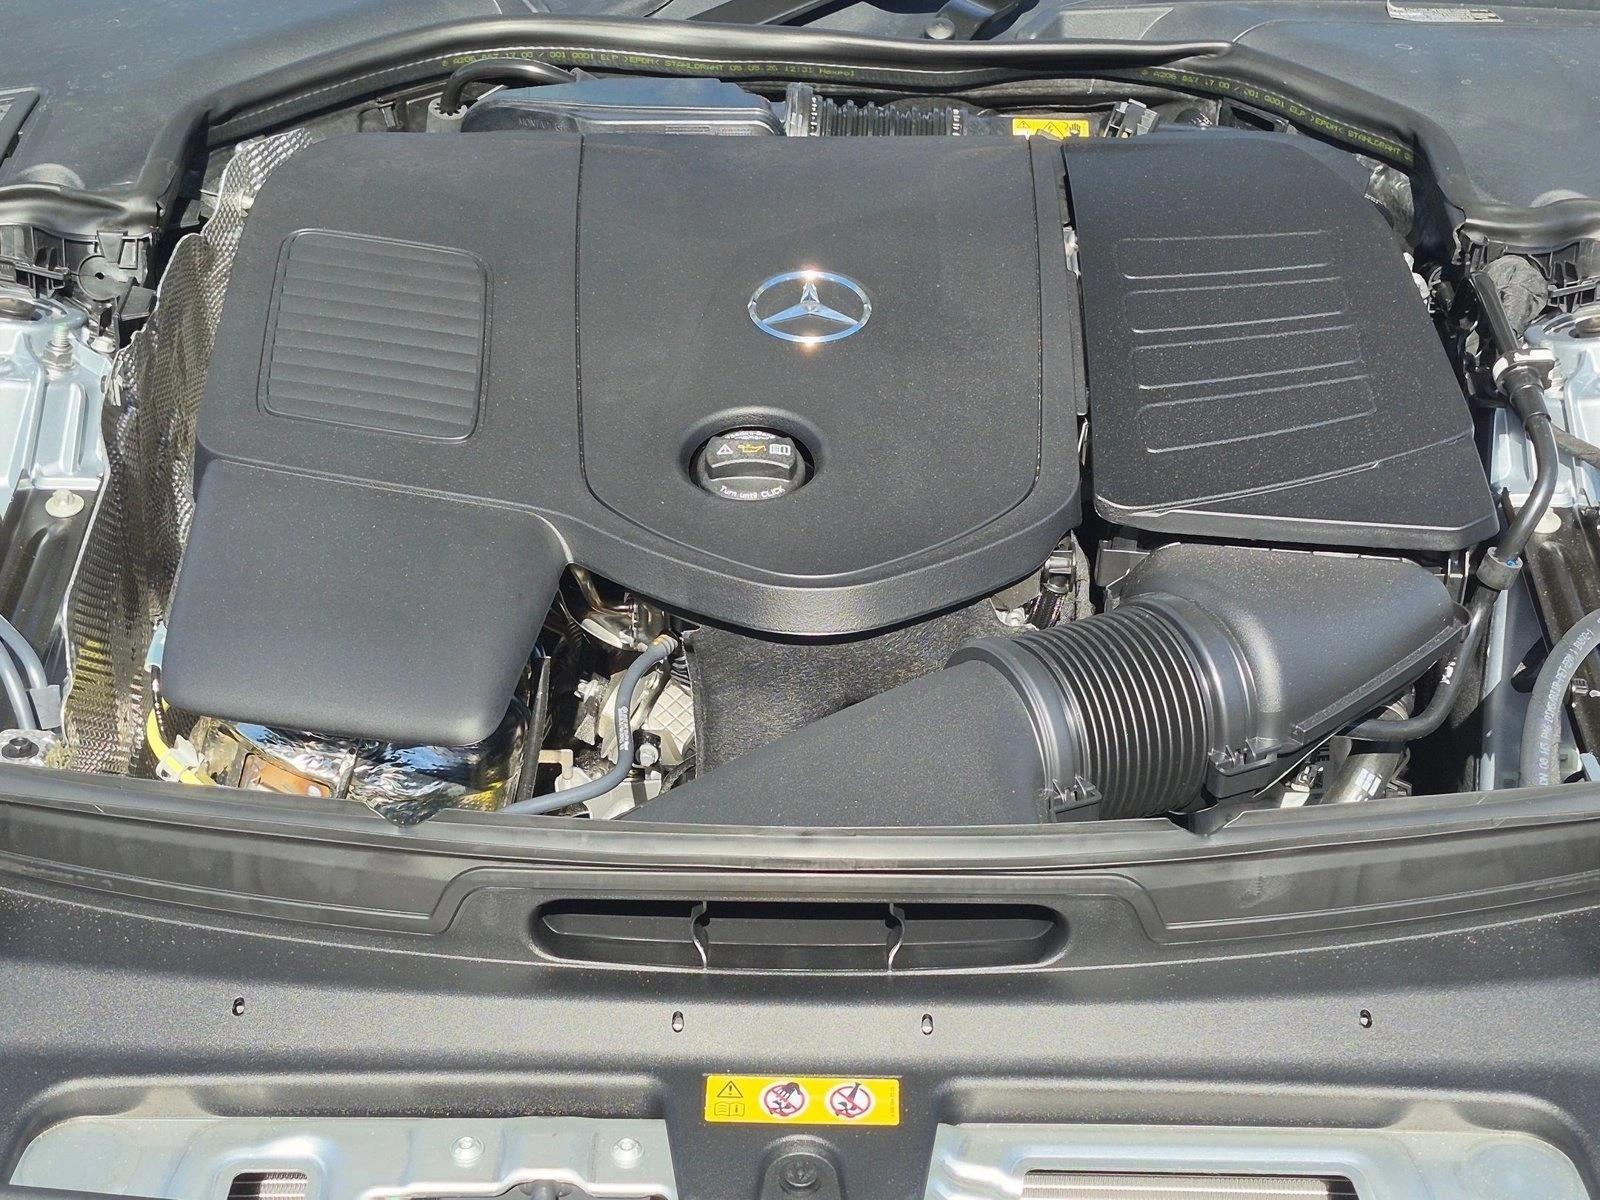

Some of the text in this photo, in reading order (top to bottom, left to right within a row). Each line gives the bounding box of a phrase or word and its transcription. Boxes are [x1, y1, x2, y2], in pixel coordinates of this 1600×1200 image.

[720, 485, 786, 499] Turn until CLICK
